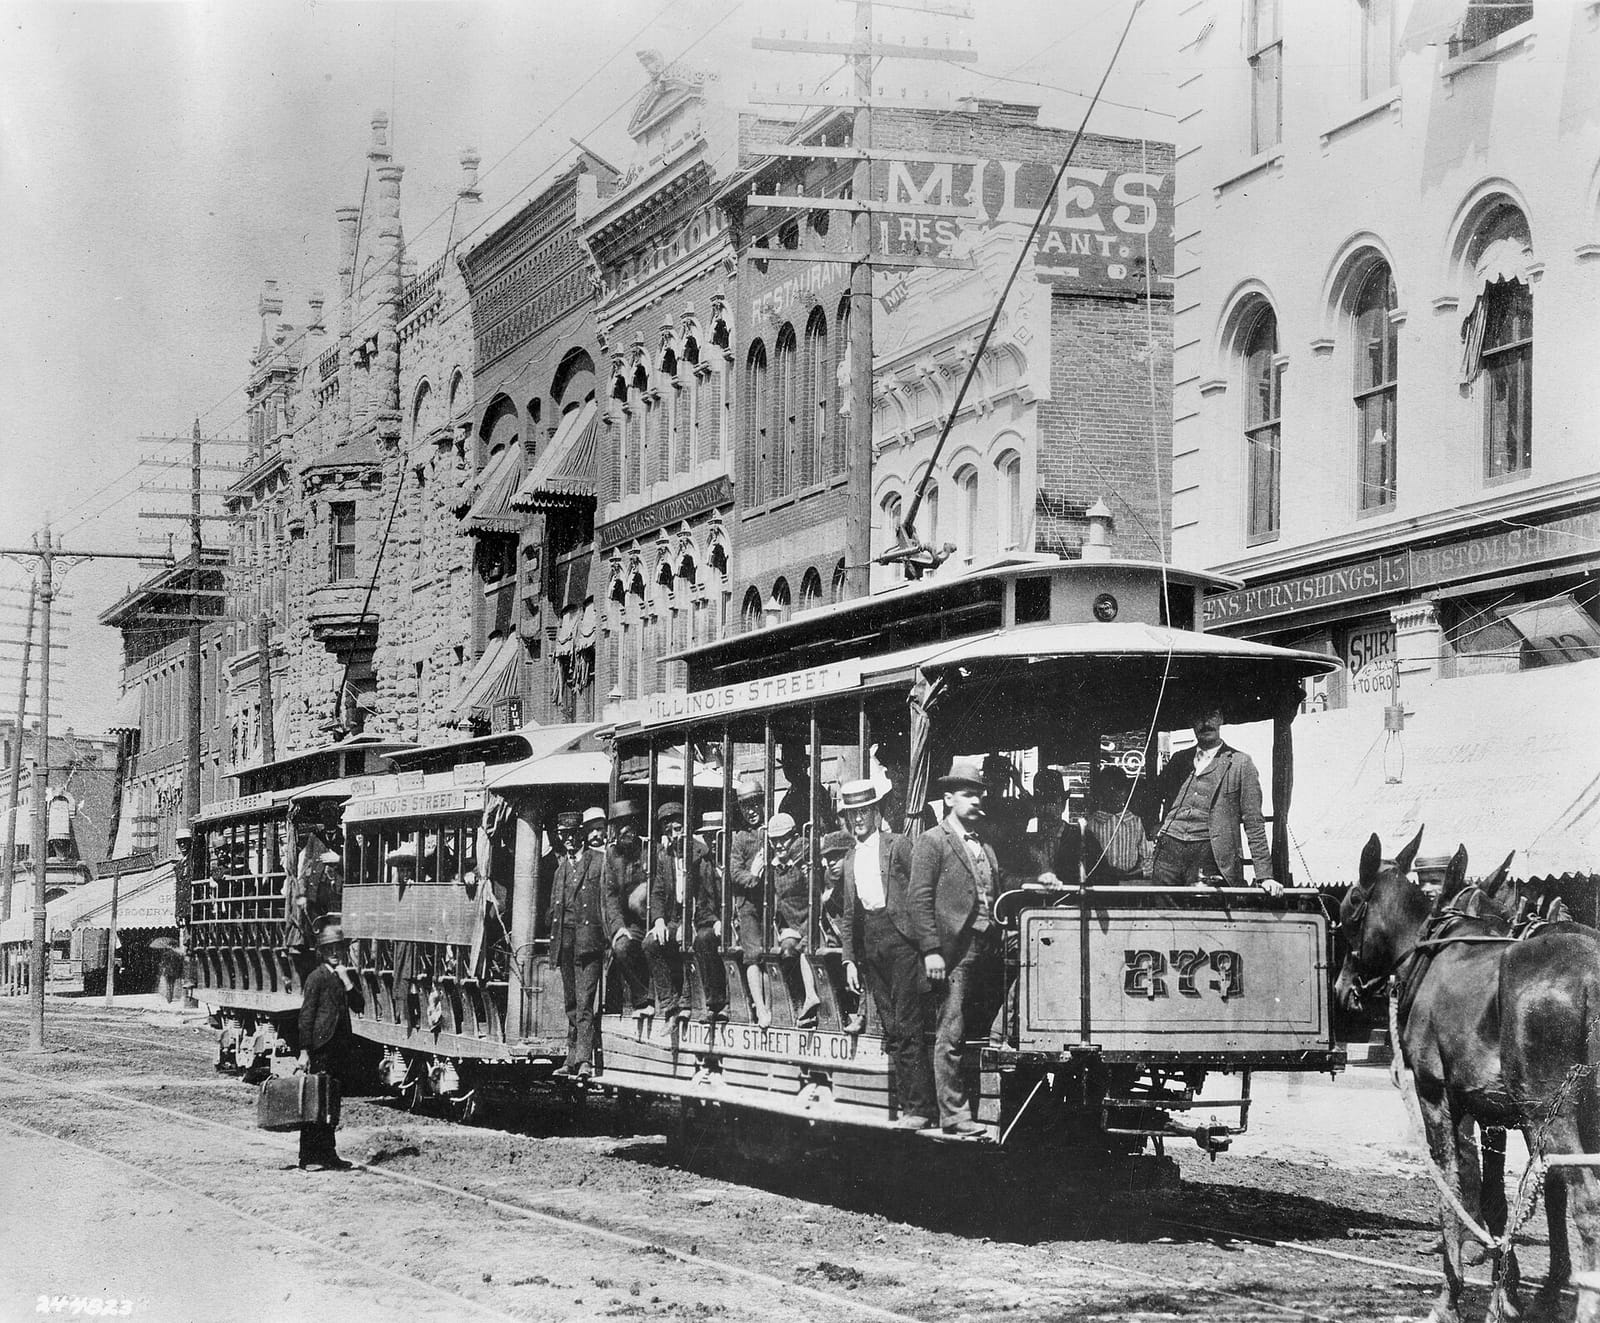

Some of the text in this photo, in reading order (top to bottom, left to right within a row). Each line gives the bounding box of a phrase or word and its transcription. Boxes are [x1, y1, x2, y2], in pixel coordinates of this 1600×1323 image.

[884, 159, 1167, 235] MILES
[602, 522, 630, 545] CHINA
[629, 509, 656, 533] GLASS
[1415, 539, 1499, 576] CUSTOM
[1203, 558, 1405, 623] ENS FURNISHINGS. 15
[656, 669, 829, 720] ILLINOIS STREET
[1358, 674, 1393, 694] TO ORD
[363, 798, 408, 817] ILLINOIS
[411, 793, 453, 811] STREET
[1123, 947, 1244, 1001] 279
[743, 1030, 791, 1054] STREET
